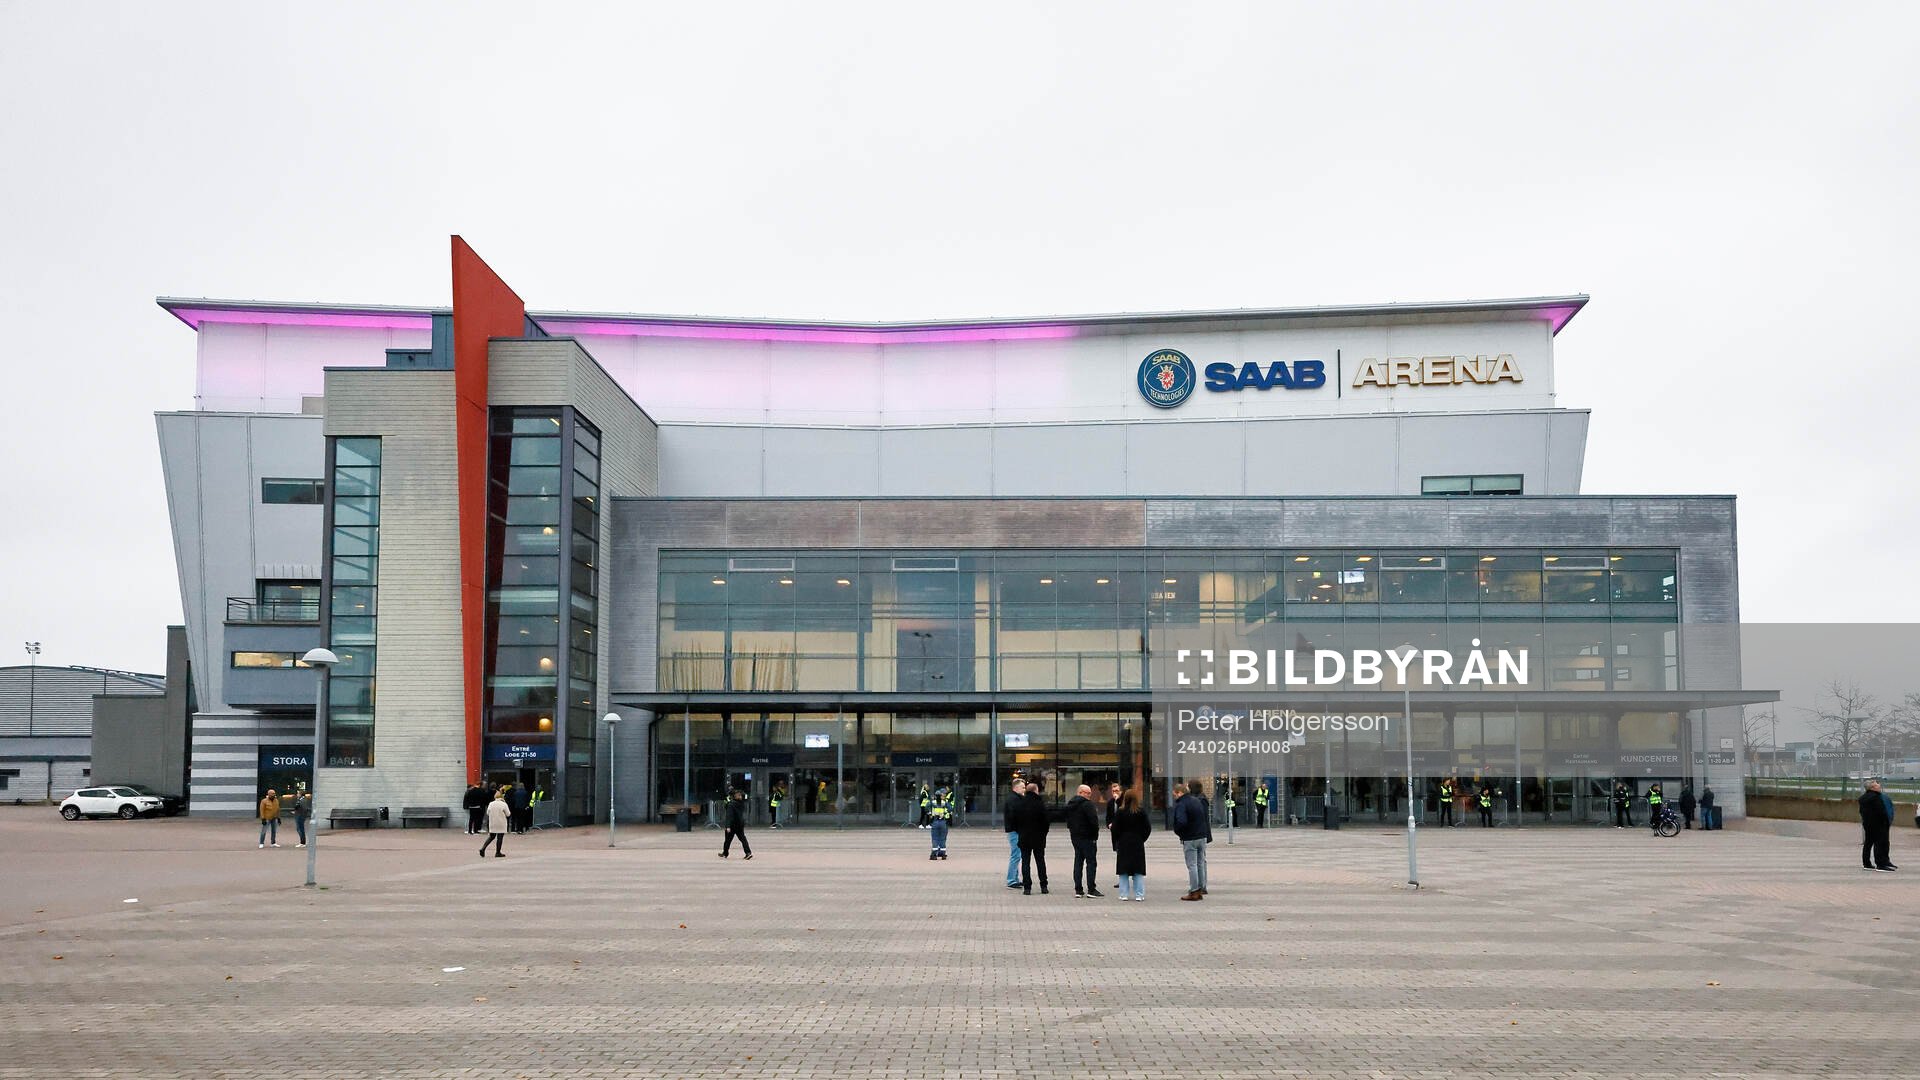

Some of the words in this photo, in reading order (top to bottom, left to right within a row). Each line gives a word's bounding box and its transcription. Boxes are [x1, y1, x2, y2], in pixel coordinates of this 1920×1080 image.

[1152, 354, 1181, 365] SAAB
[1204, 359, 1326, 392] SAAB
[1352, 353, 1524, 388] ARENA
[1150, 387, 1185, 401] TECHNOLOGIES
[272, 757, 308, 766] STORA
[1620, 755, 1678, 763] KUNDCENTER
